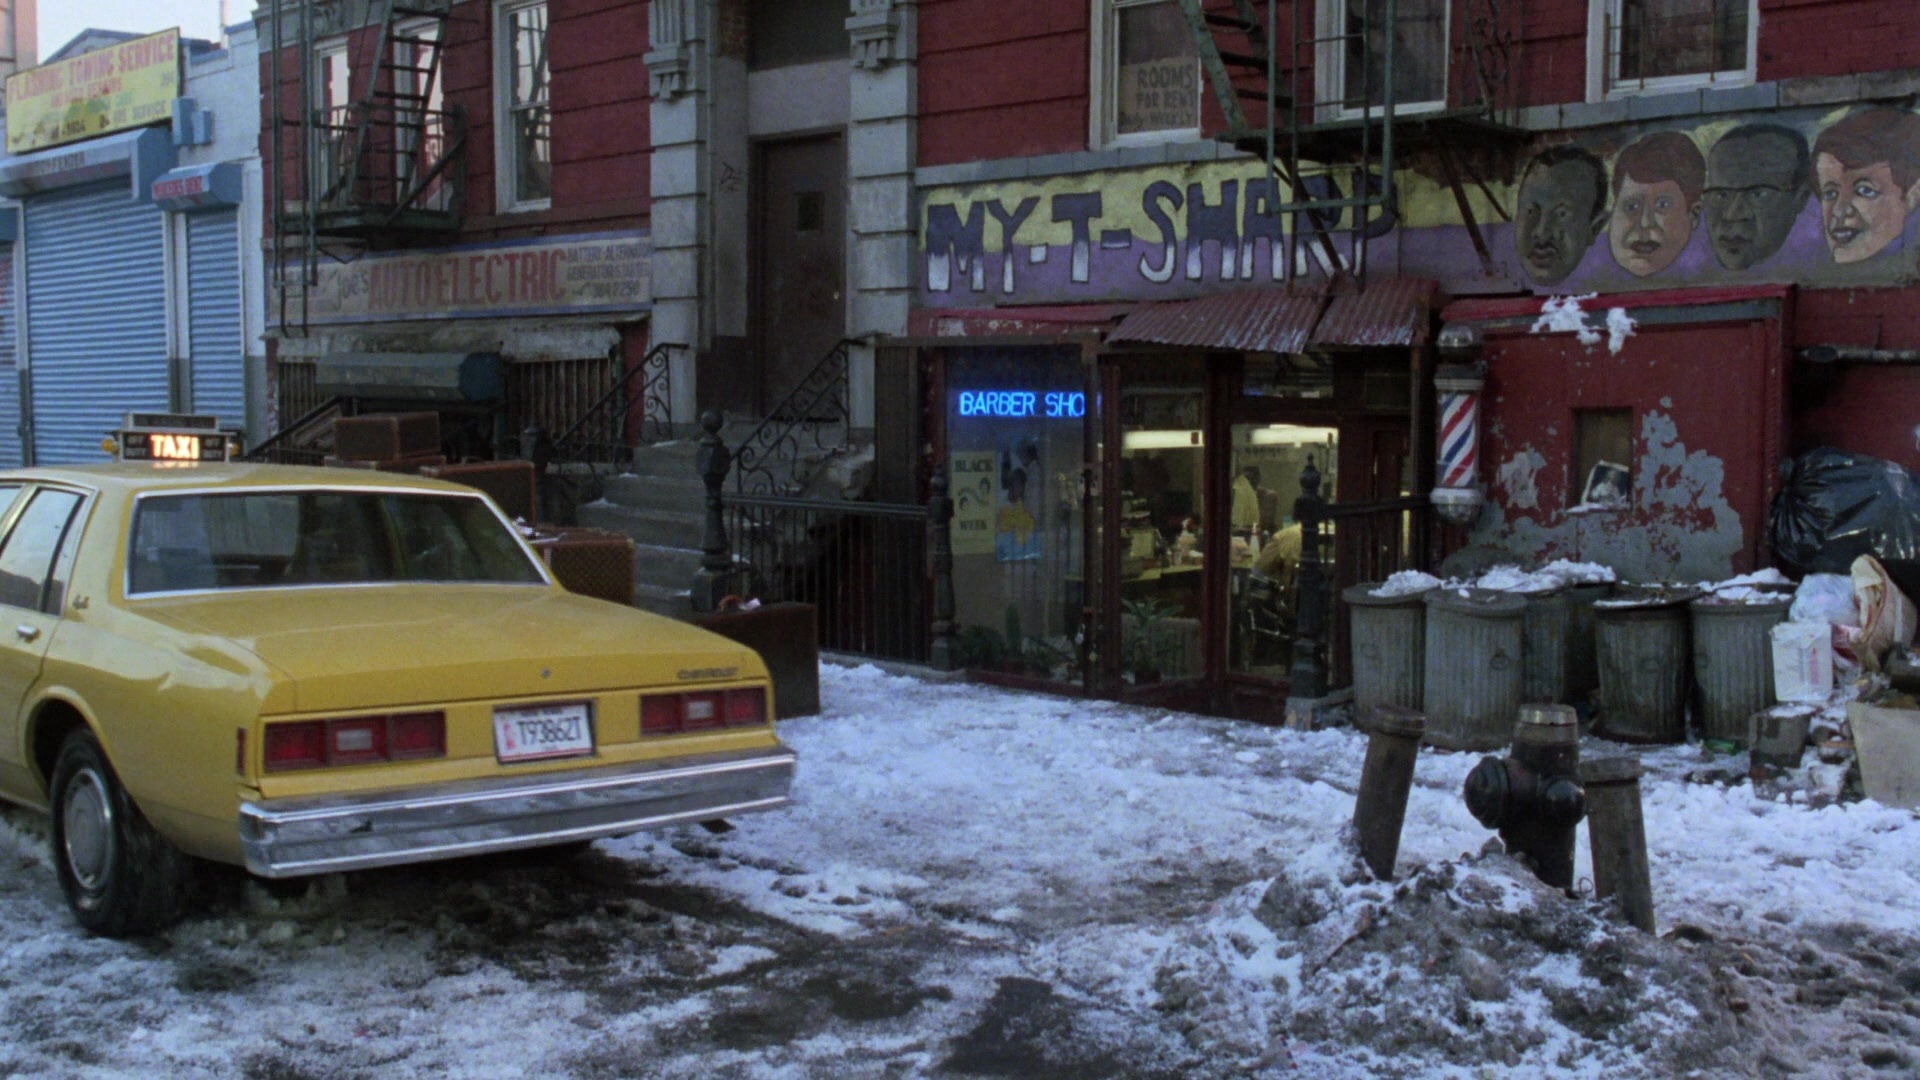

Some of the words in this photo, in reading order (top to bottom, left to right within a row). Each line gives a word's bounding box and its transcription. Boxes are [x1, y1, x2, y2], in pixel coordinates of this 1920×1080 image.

[69, 42, 115, 86] TOWING
[118, 33, 176, 73] SERVICE
[1137, 65, 1193, 89] ROOMS
[367, 254, 433, 309] AUTO
[437, 248, 567, 304] ELECTRIC
[959, 391, 1036, 416] BARBER
[1045, 391, 1086, 417] SHO
[151, 434, 200, 459] TAXI
[955, 459, 993, 473] BLACK
[517, 716, 580, 745] T93862T
